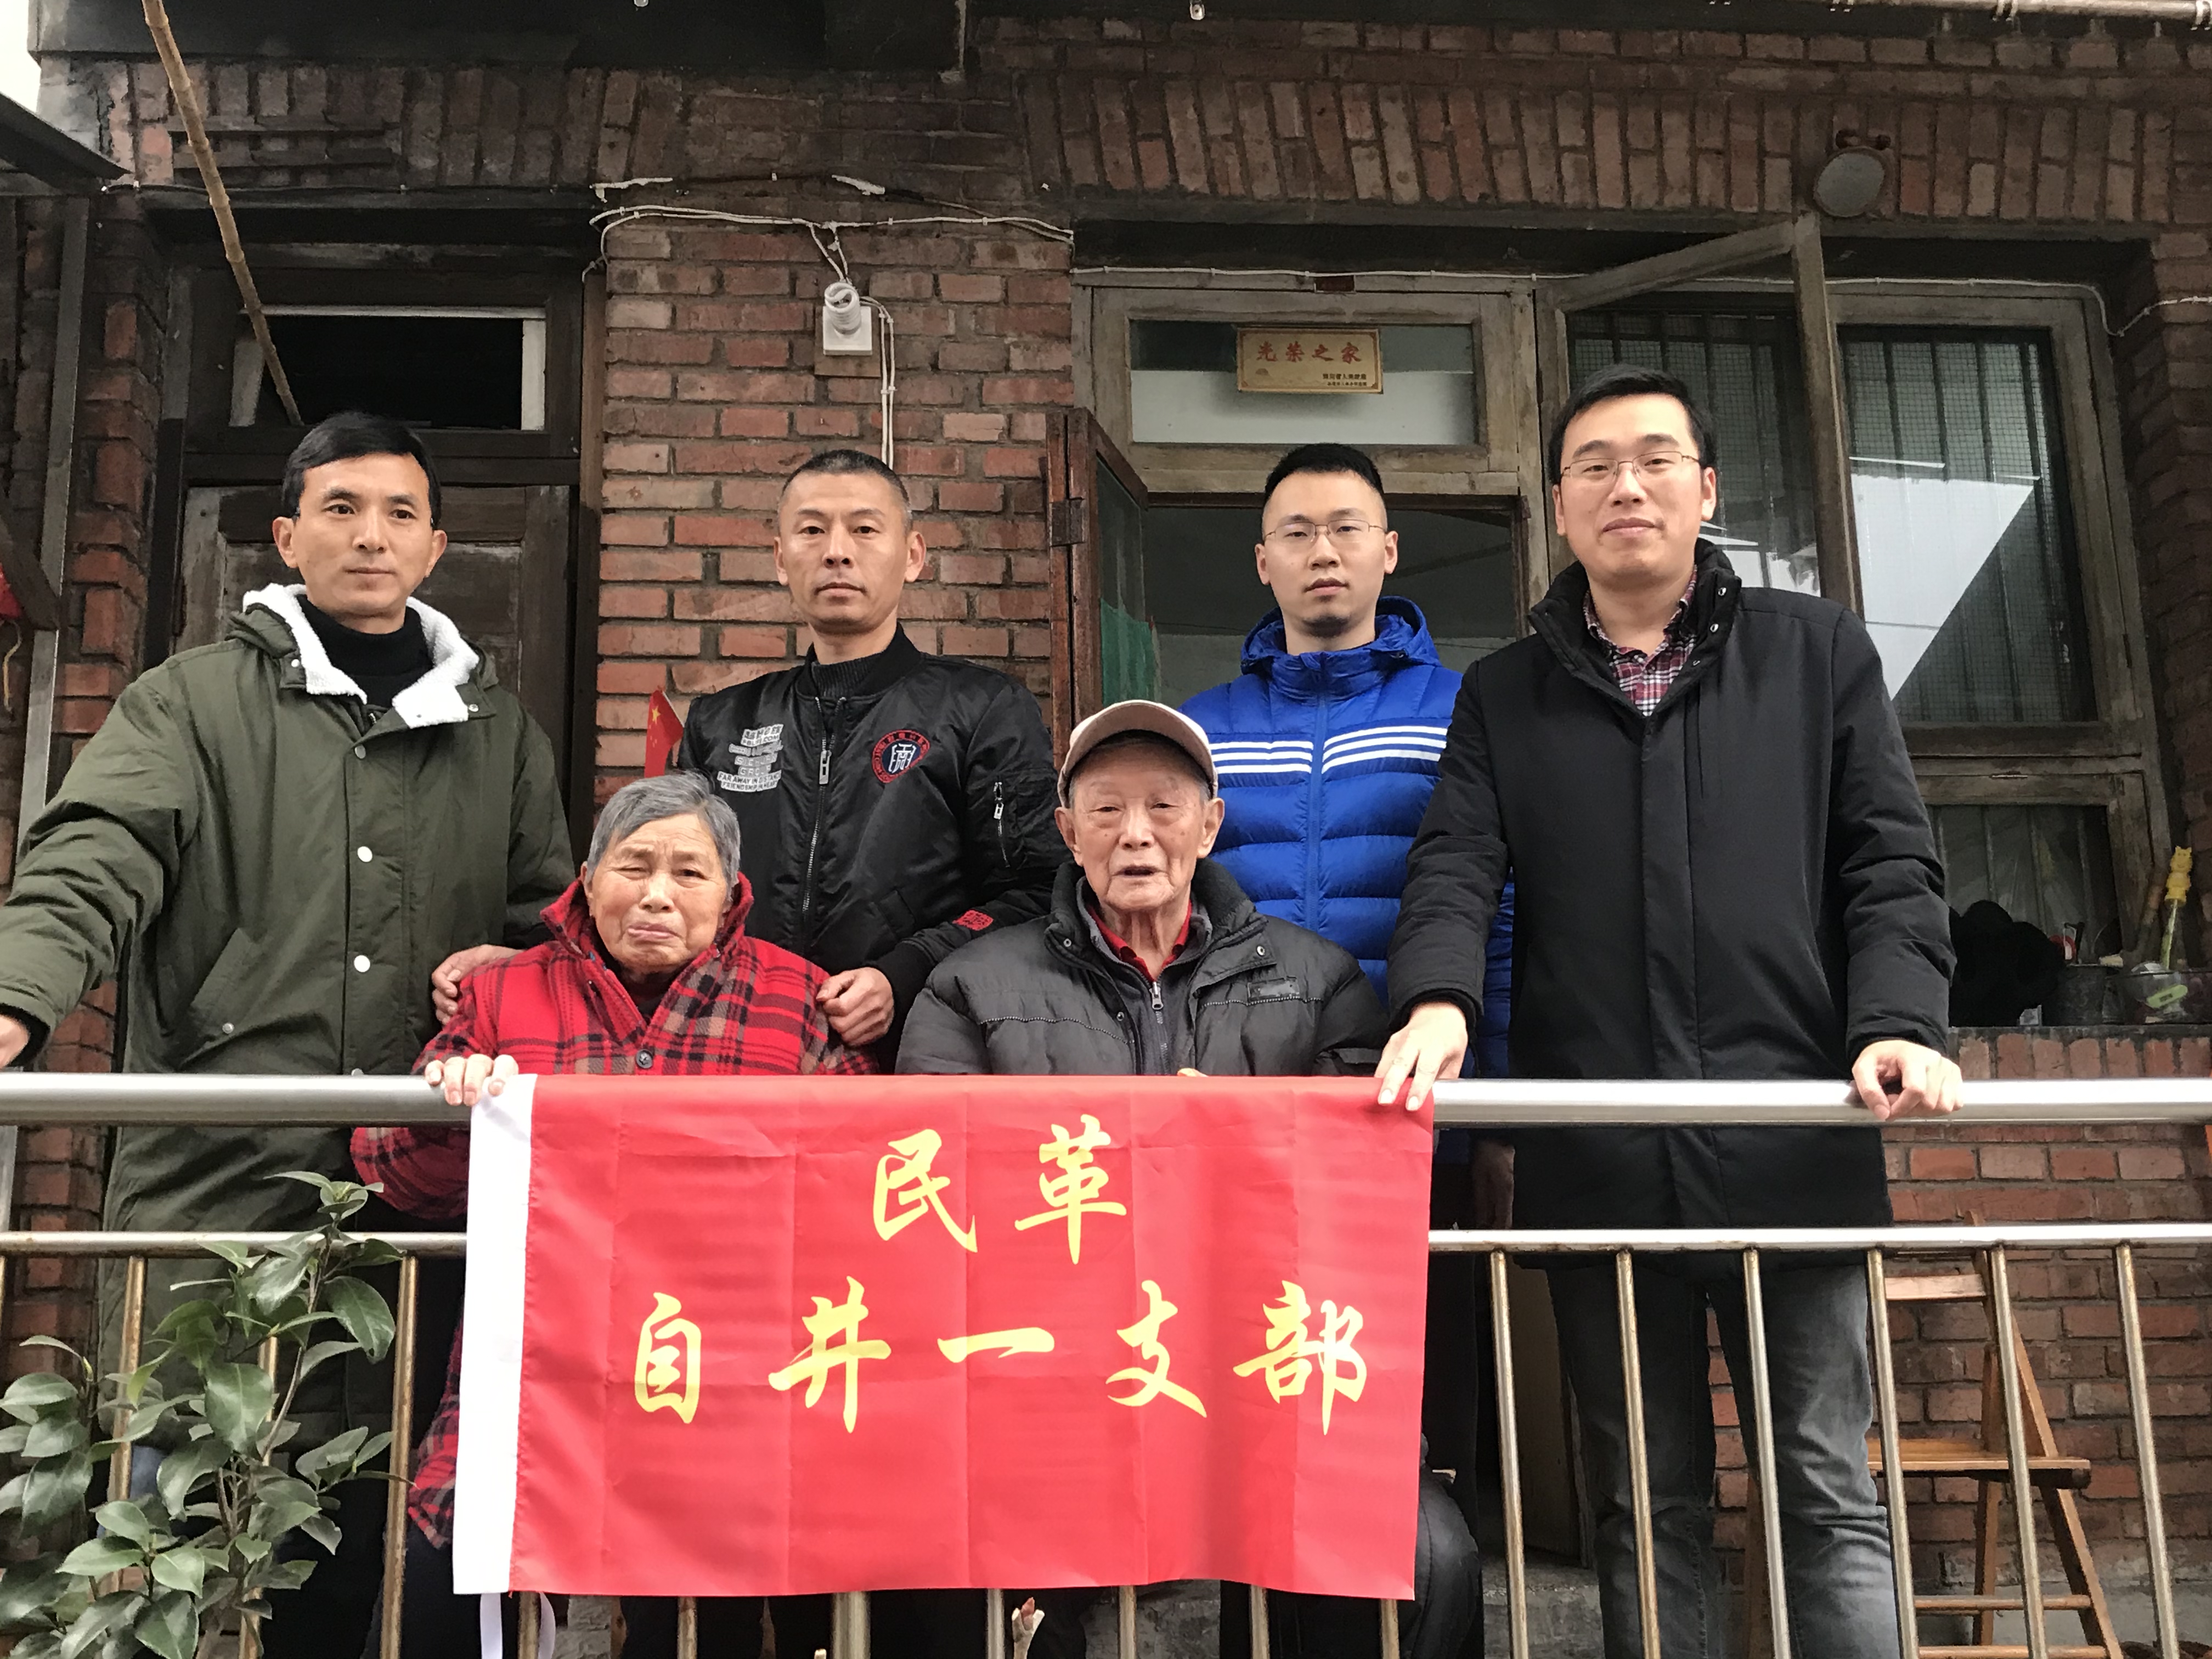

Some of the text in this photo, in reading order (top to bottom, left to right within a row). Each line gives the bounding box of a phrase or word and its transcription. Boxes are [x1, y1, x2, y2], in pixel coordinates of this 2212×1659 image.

[1256, 341, 1362, 364] 光荣之家
[733, 775, 750, 783] AWAY
[873, 1114, 1127, 1264] 民革
[634, 1276, 1367, 1434] 自井一支部
